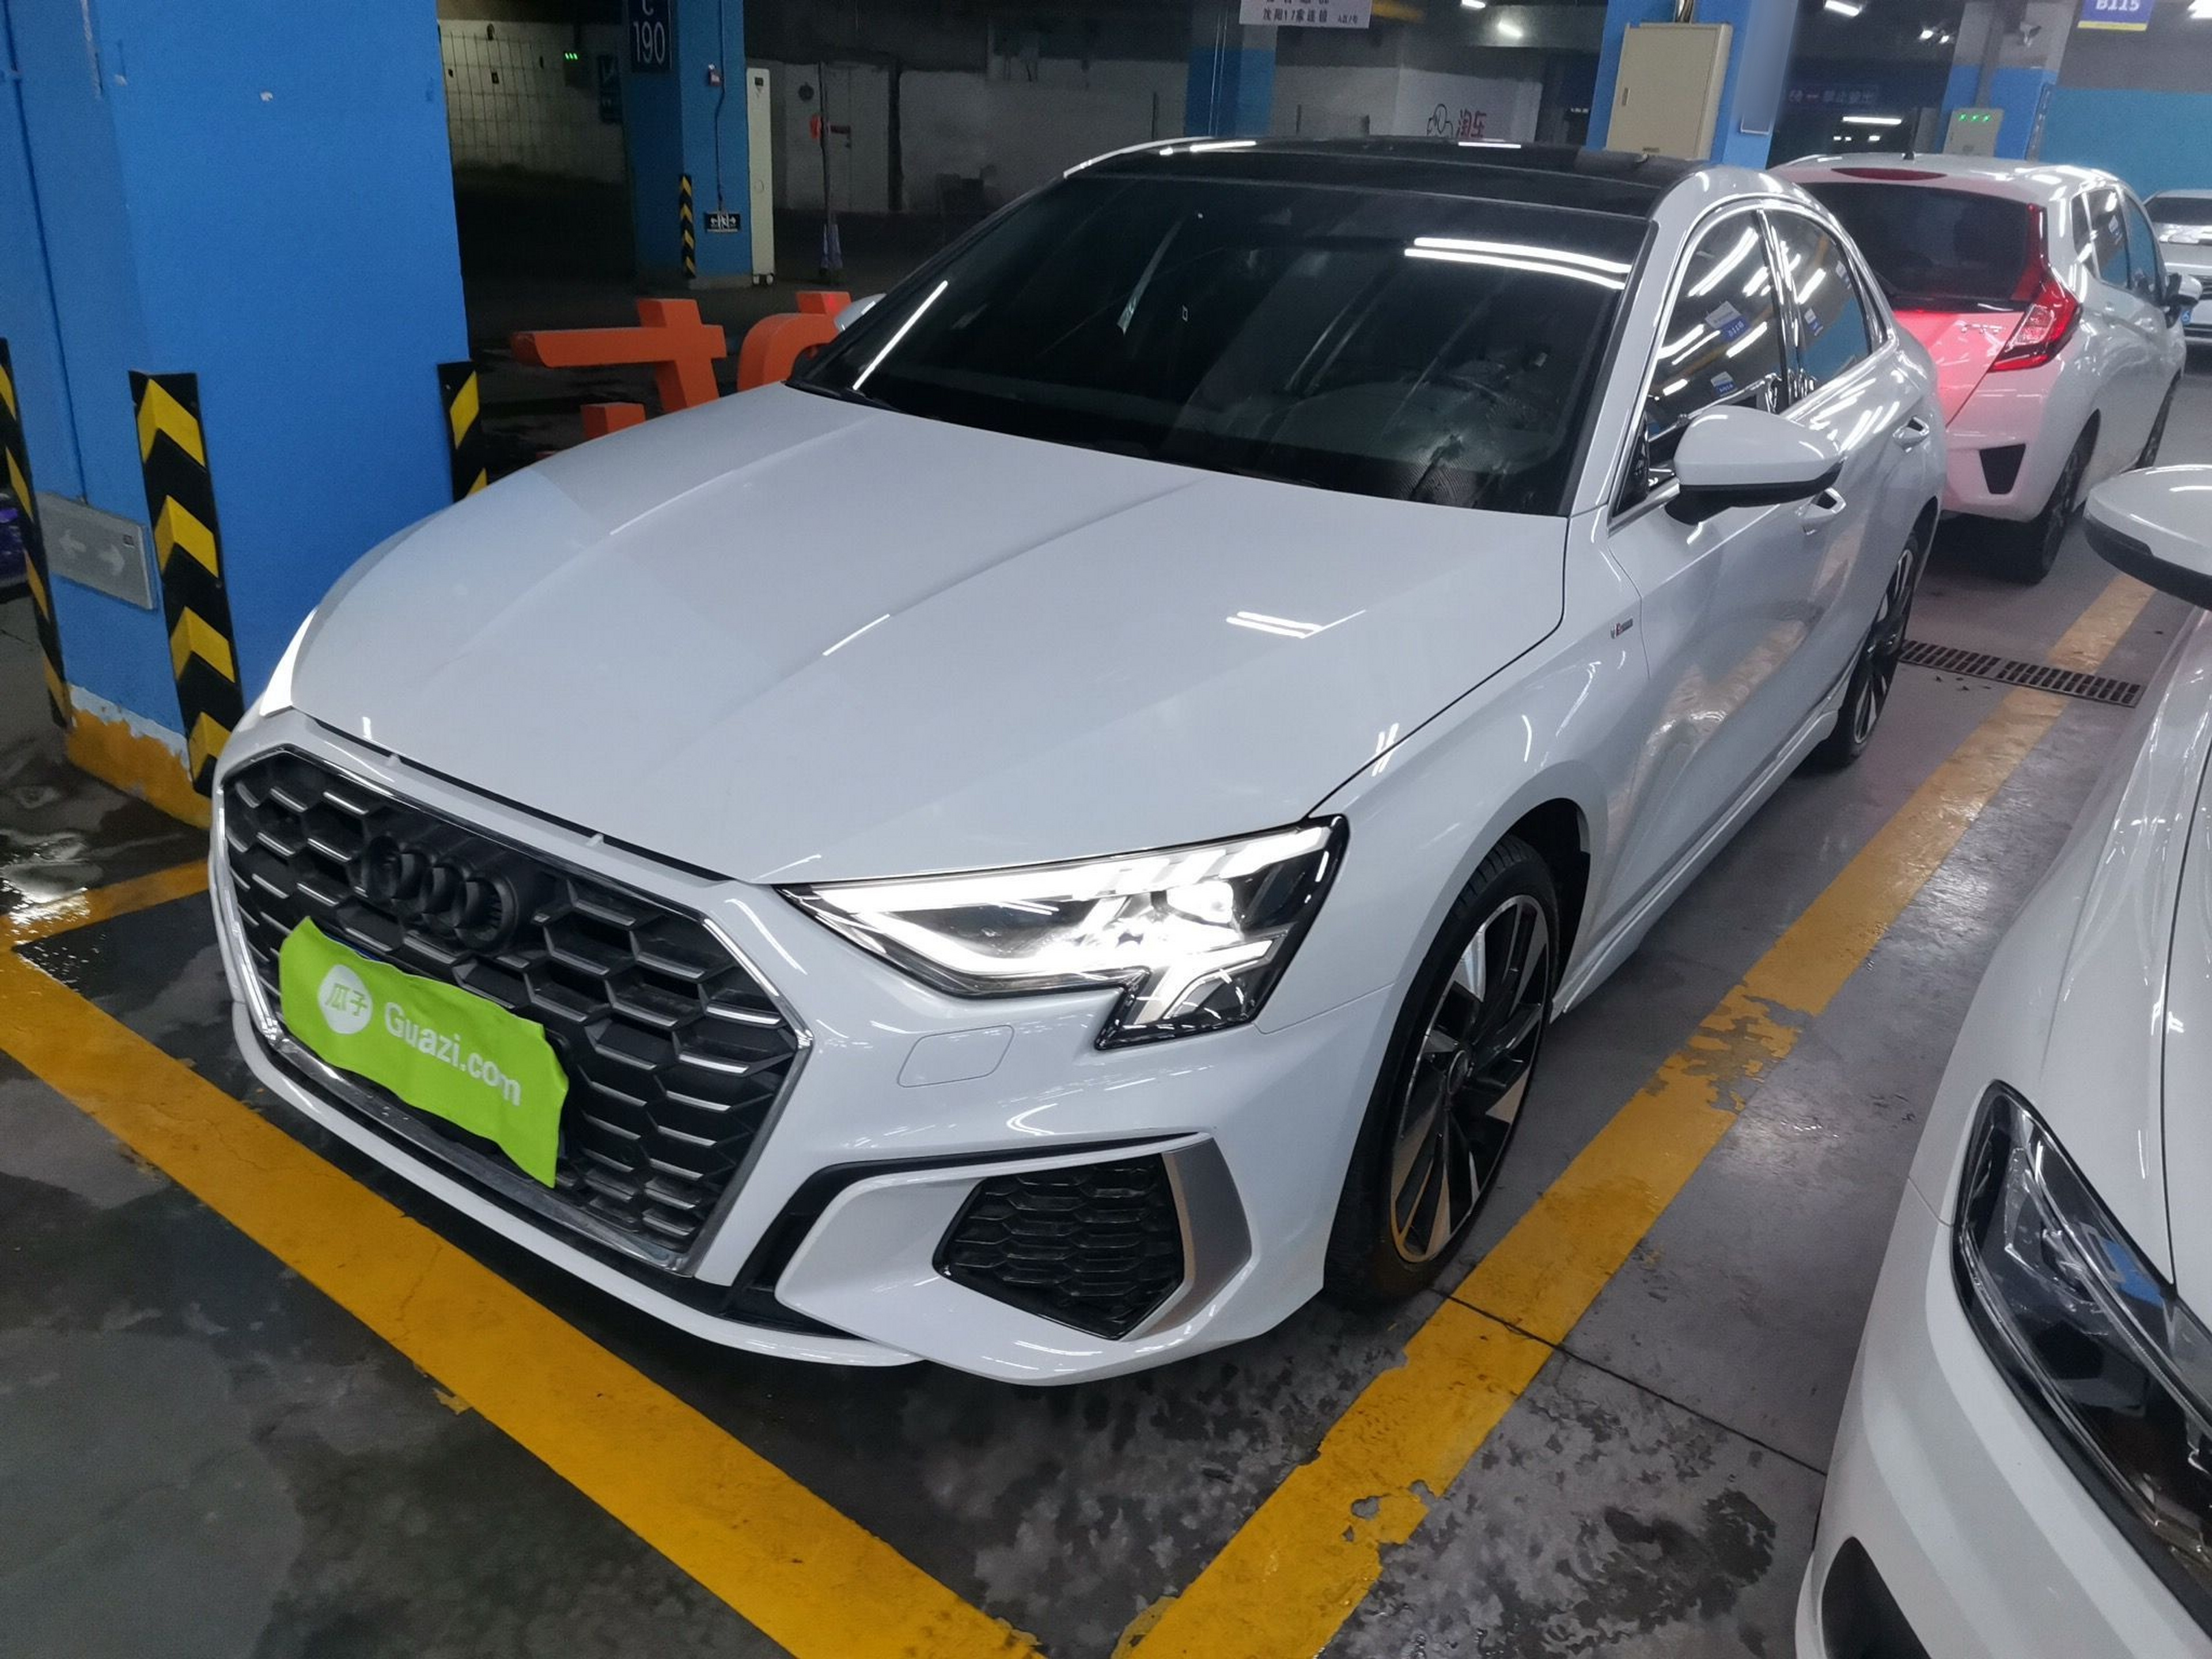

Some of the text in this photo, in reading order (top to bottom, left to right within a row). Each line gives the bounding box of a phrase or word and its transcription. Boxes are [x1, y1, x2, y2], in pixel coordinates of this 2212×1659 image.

[634, 21, 665, 65] 190
[325, 982, 367, 1017] 瓜子
[384, 1002, 522, 1107] Guazi.com
